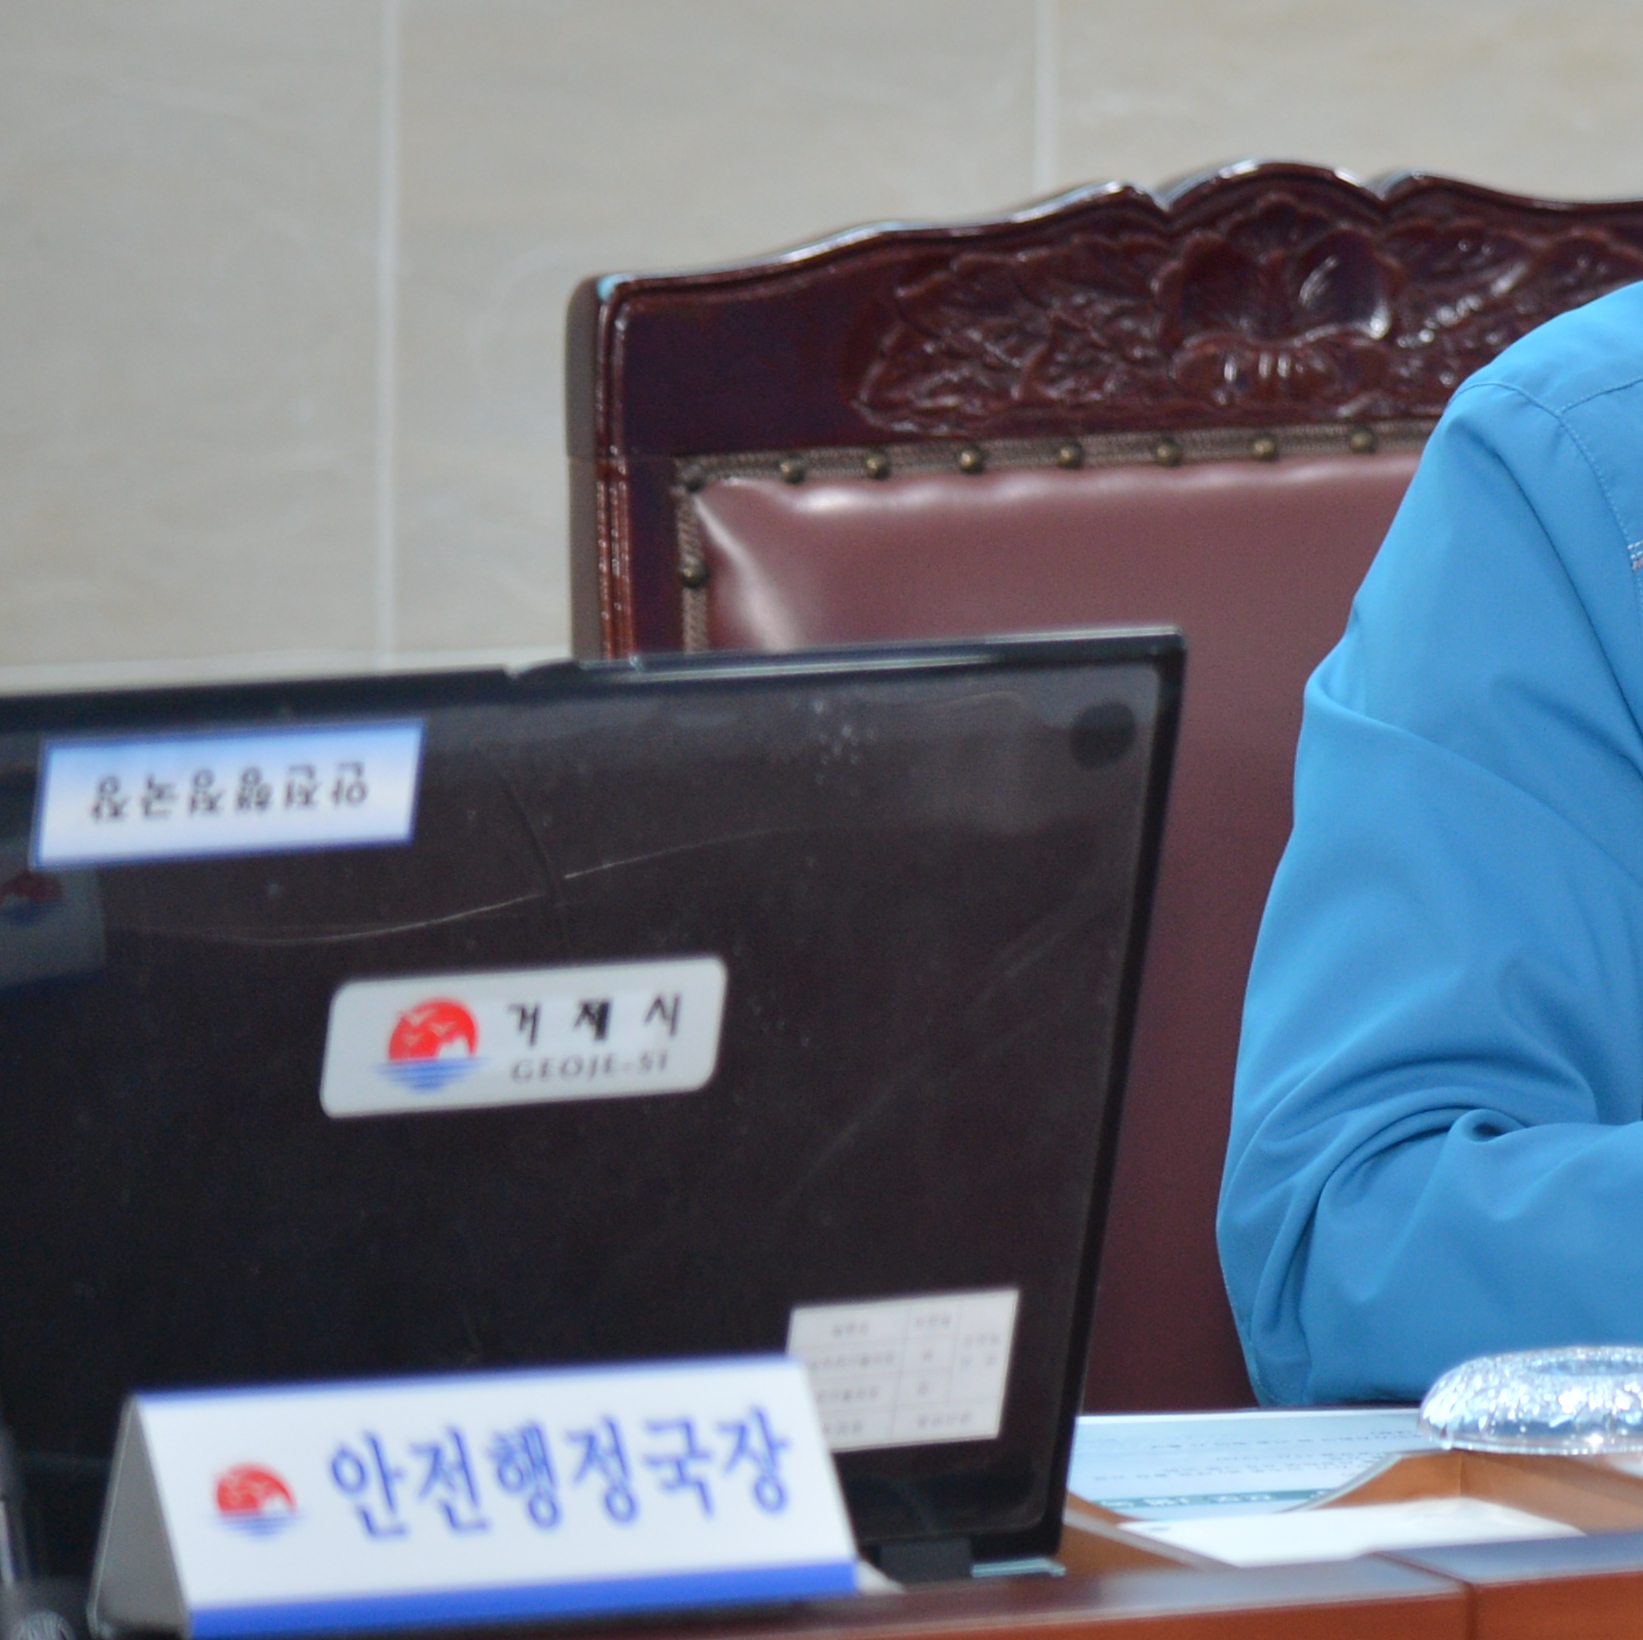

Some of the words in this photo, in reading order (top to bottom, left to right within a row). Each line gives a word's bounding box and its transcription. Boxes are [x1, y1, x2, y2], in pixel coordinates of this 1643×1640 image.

[89, 760, 368, 823] 안전행정국장
[507, 992, 683, 1048] 거제시
[510, 1050, 670, 1082] GEOJE-SI
[329, 1403, 790, 1545] 안전행정국장
